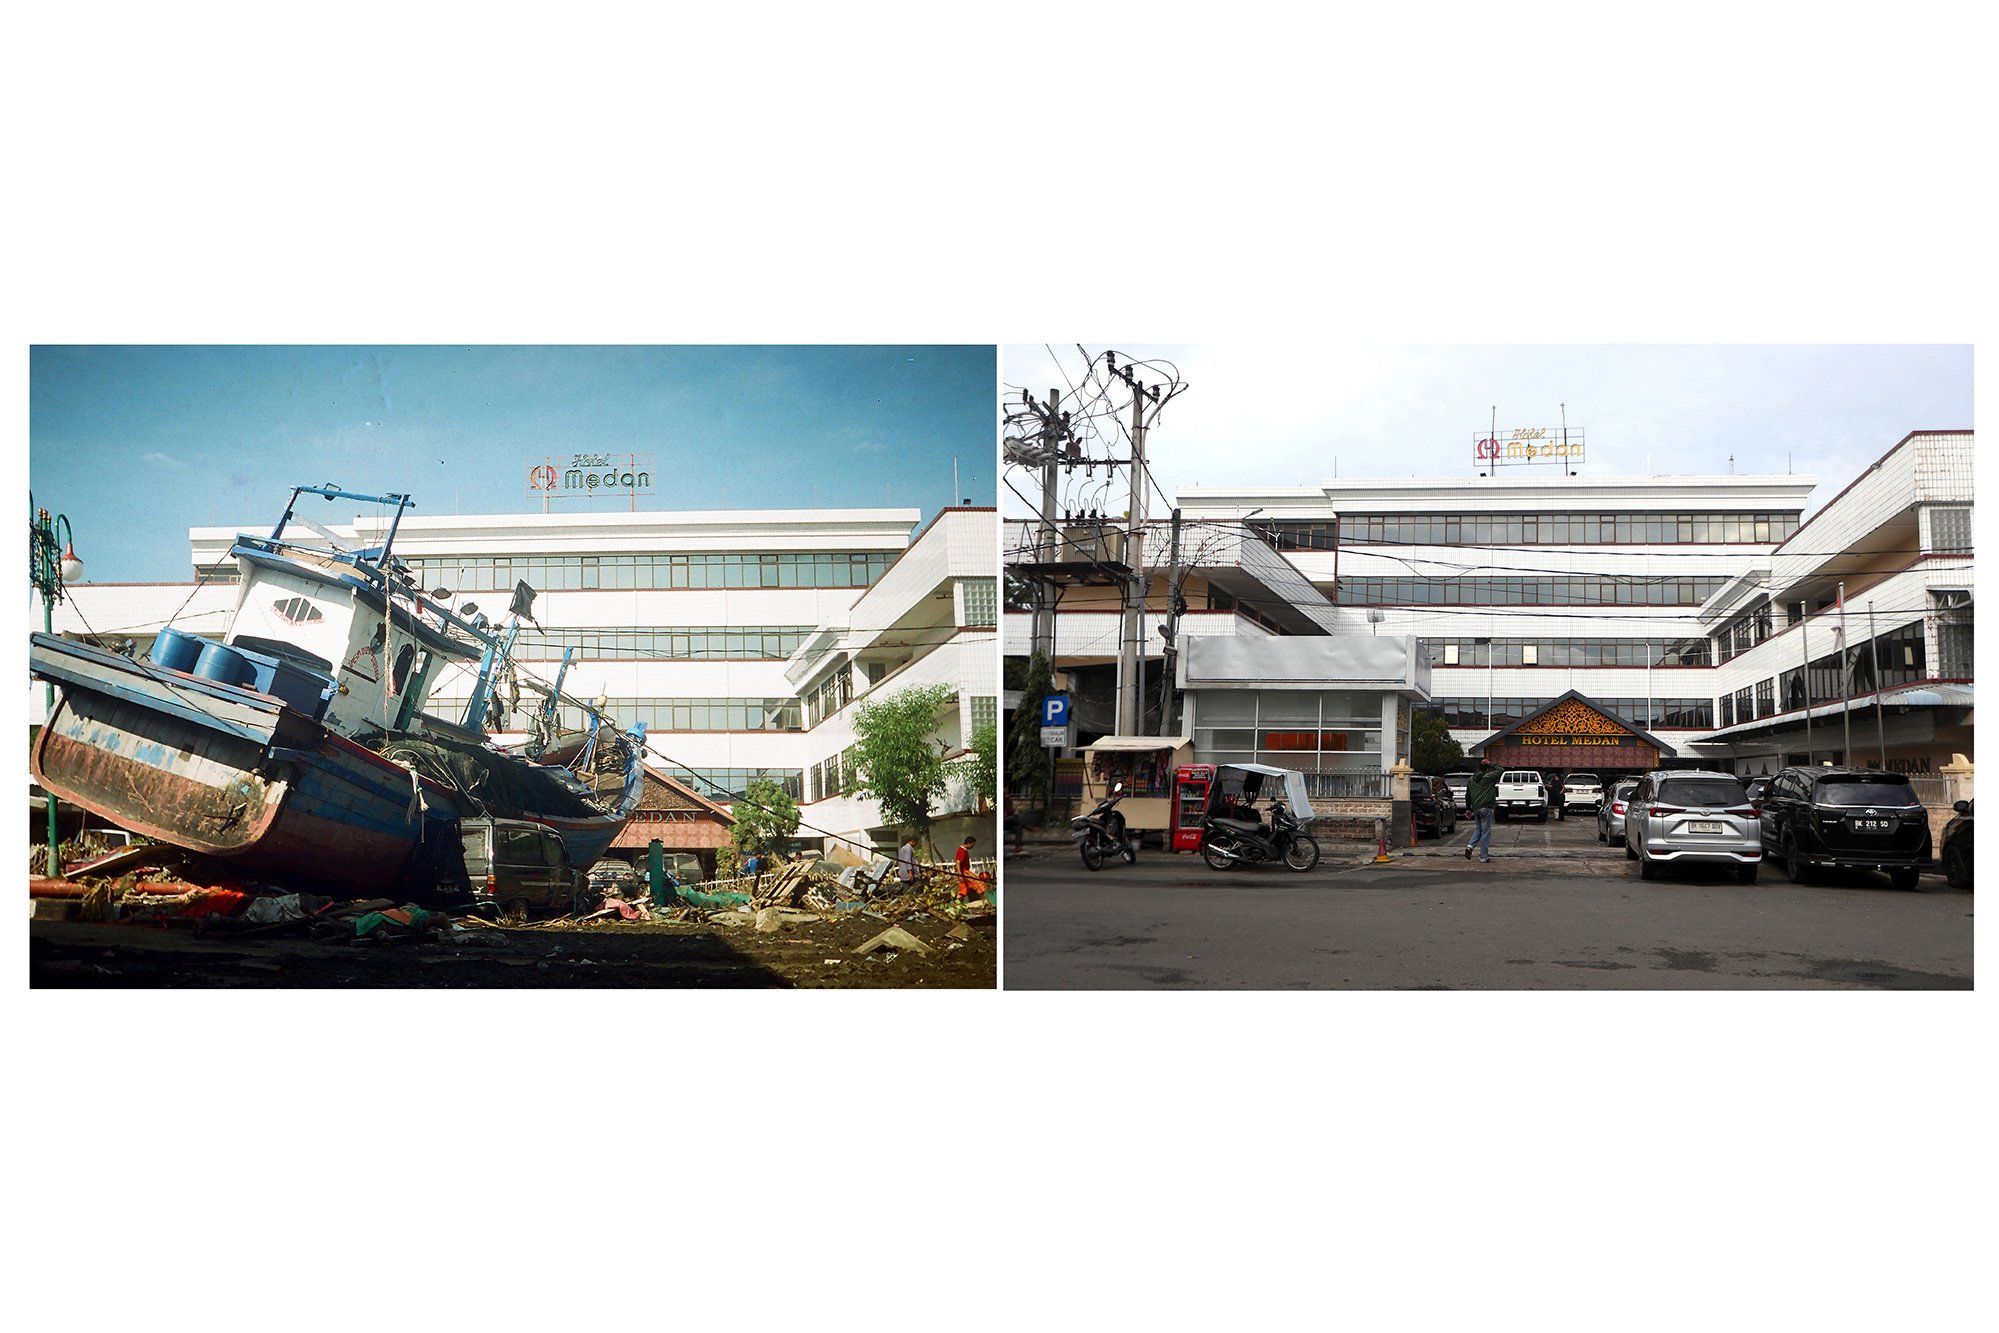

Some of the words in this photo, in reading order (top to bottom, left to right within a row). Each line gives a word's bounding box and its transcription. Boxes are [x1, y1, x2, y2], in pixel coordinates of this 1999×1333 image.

[1512, 428, 1546, 440] Hotel
[1507, 440, 1581, 459] Medan
[571, 453, 610, 468] Hotel
[564, 468, 650, 489] Medan
[1047, 700, 1064, 721] P
[1522, 735, 1568, 745] HOTEL
[1571, 735, 1619, 745] MEDAN
[634, 811, 698, 823] EDAN
